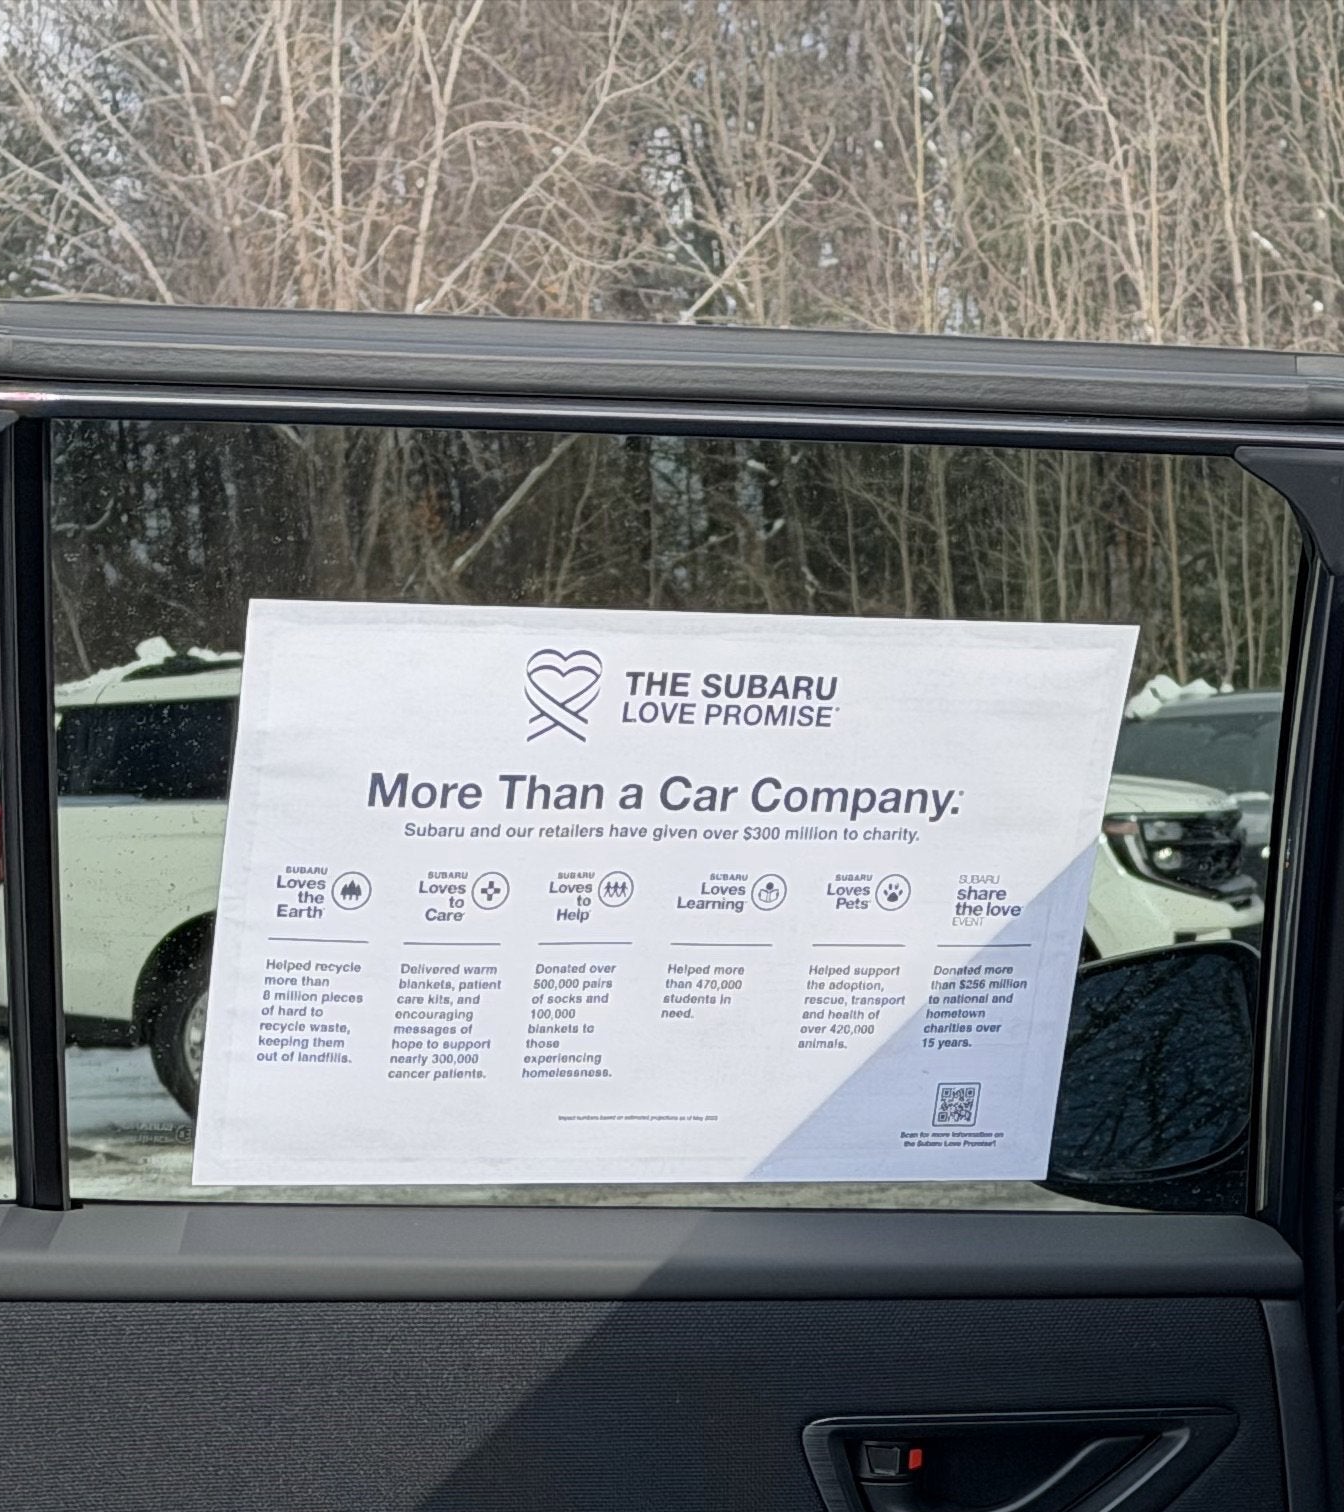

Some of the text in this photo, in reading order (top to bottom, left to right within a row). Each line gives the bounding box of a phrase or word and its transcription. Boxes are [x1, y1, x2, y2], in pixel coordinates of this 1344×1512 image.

[626, 671, 837, 701] THE SUBARU
[622, 701, 840, 727] LOVE PROMISE
[368, 772, 964, 822] More Than a Car Company.
[404, 822, 919, 844] Subaru and our retailers have given over $300 million to charity.
[285, 866, 328, 875] SUBARU
[428, 871, 468, 879] SUBARU
[710, 873, 748, 881] SUBARU
[276, 875, 326, 890] Loves
[835, 874, 873, 882] SUBARU
[958, 874, 1000, 885] SUBARU
[419, 880, 466, 895] Loves
[549, 881, 593, 894] Loves
[701, 882, 746, 896] Loves
[827, 883, 871, 896] Loves
[957, 885, 1007, 901] share
[298, 891, 324, 904] the
[449, 896, 465, 908] to
[577, 895, 591, 907] to
[836, 897, 871, 910] Pets
[677, 896, 745, 913] Learning
[955, 901, 1021, 917] the love
[277, 904, 323, 919] Earth
[425, 908, 465, 922] Care
[556, 908, 590, 923] Help
[952, 916, 985, 927] EVENT
[266, 959, 361, 974] Helped recycle
[401, 963, 497, 975] Delivered warm
[535, 963, 616, 974] Donated over
[667, 964, 745, 977] Helped more
[809, 965, 900, 978] Helped support
[933, 965, 1013, 976] Donated more
[264, 976, 330, 987] more than
[399, 978, 502, 992] blankets, patient
[533, 977, 612, 991] 500,000 pairs
[665, 979, 742, 991] than 470,000
[807, 980, 884, 993] the adoption,
[931, 980, 956, 991] than
[988, 978, 1027, 989] million
[262, 990, 363, 1005] 8 million pieces
[397, 994, 480, 1006] care kits, and
[531, 993, 609, 1004] of socks and
[663, 993, 731, 1005] students in
[804, 995, 906, 1008] rescue, transport
[928, 993, 1014, 1005] to national and
[261, 1005, 324, 1017] of hard to
[395, 1009, 473, 1022] encouraging
[531, 1008, 576, 1021] 100,000
[661, 1008, 694, 1018] need.
[802, 1009, 880, 1020] and health of
[926, 1008, 986, 1019] hometown
[259, 1021, 350, 1035] recycle waste,
[393, 1024, 473, 1037] messages of
[528, 1023, 595, 1034] blankets to
[800, 1024, 875, 1036] over 420,000
[923, 1022, 1002, 1033] charities over
[258, 1035, 345, 1050] keeping them
[392, 1038, 491, 1052] hope to support
[526, 1038, 560, 1049] those
[798, 1038, 847, 1049] animals.
[922, 1038, 972, 1050] 15 years.
[256, 1051, 352, 1063] out of landfills.
[390, 1053, 479, 1067] nearly 300,000
[523, 1052, 602, 1066] experiencing
[388, 1068, 486, 1081] cancer patients.
[522, 1067, 612, 1078] homelessness.
